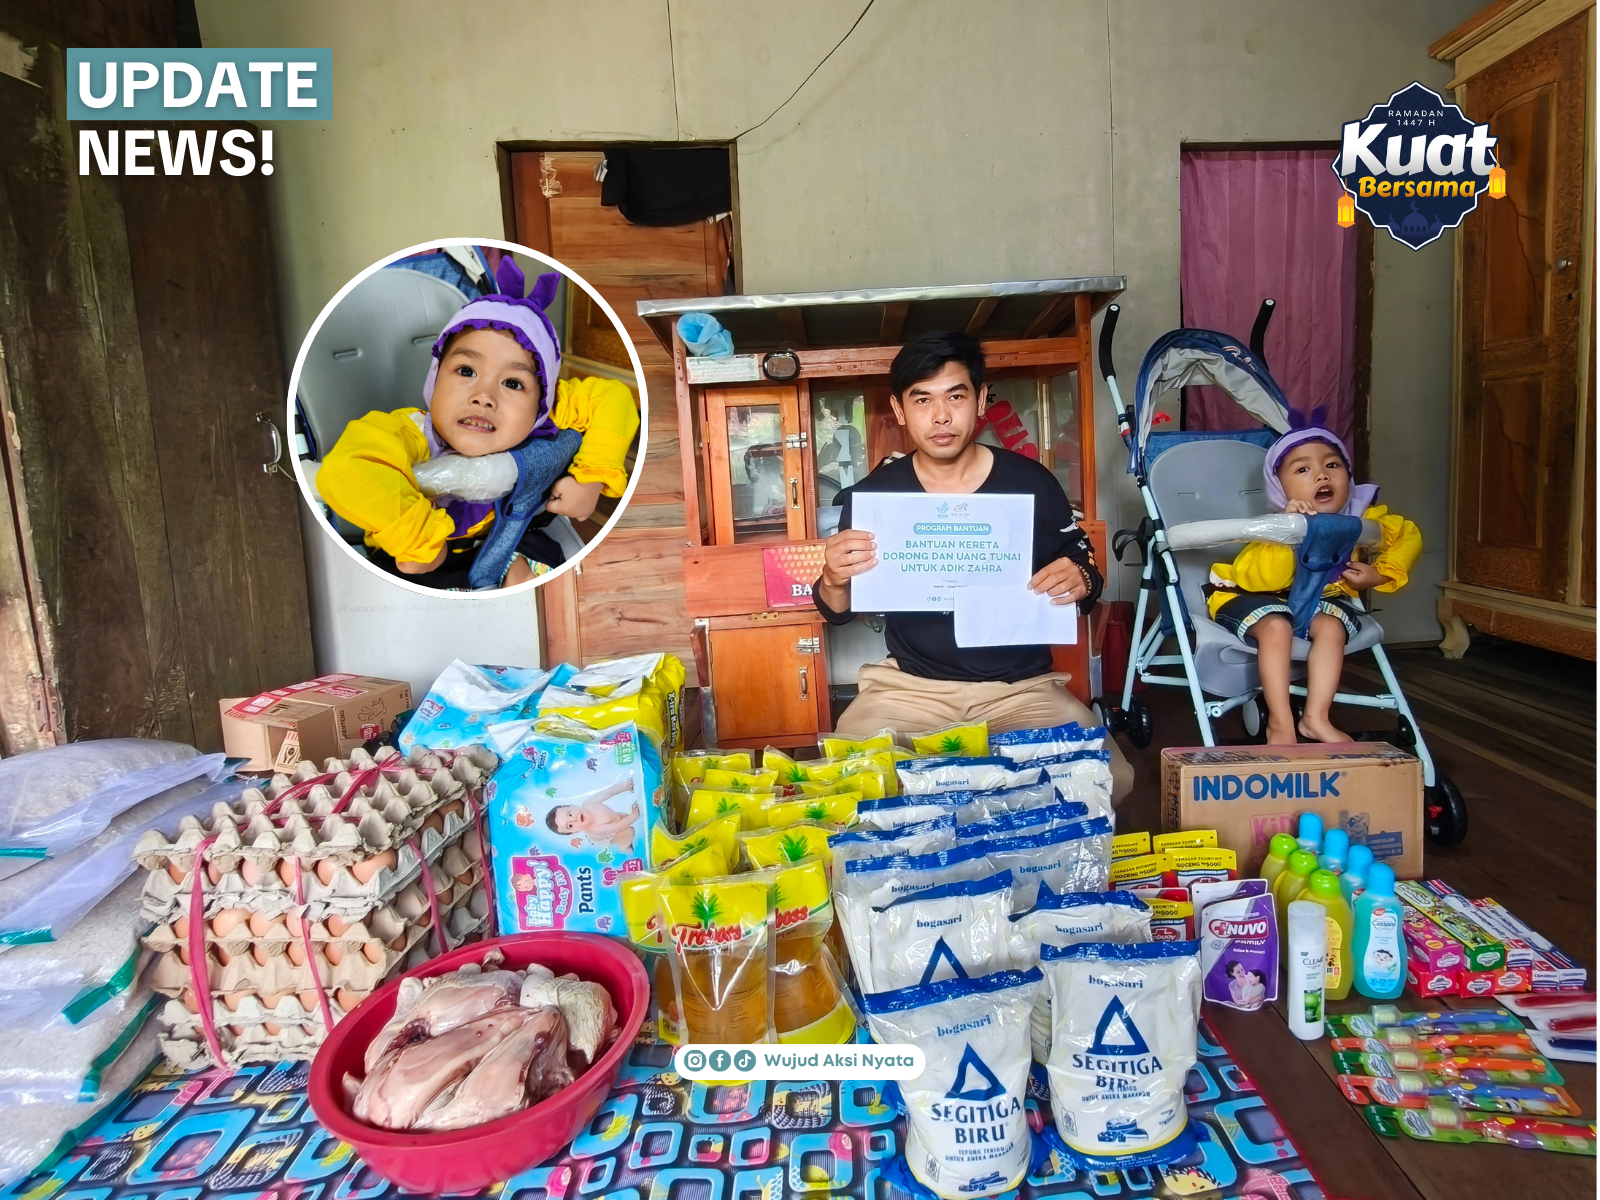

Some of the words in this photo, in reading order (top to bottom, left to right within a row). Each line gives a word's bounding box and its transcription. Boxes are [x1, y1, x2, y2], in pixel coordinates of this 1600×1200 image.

[916, 524, 952, 532] PROGRAM
[953, 524, 989, 532] BANTUAN
[905, 540, 956, 549] BANTUAN
[958, 540, 999, 549] KERETA
[883, 552, 929, 561] DORONG
[931, 552, 954, 561] DAN
[956, 552, 986, 561] UANG
[989, 552, 1021, 561] TUNAI
[901, 563, 938, 572] UNTUK
[940, 564, 965, 573] ADIK
[967, 564, 1002, 573] ZAHRA
[791, 583, 813, 597] BA
[622, 742, 632, 763] M32
[935, 778, 970, 788] bogasari
[1193, 771, 1340, 801] INDOMILK
[1019, 860, 1061, 874] bogasari
[554, 869, 567, 886] Fit
[526, 860, 555, 927] Happy!
[578, 867, 594, 914] Pants
[556, 886, 570, 915] Body
[526, 895, 539, 927] Baby
[916, 914, 962, 929] bogasari
[1055, 922, 1103, 935] bogasari
[1227, 921, 1267, 936] NUVO
[1302, 956, 1324, 966] CLEAR
[937, 1014, 991, 1037] bogasari
[1072, 1053, 1163, 1076] SEGITIGA
[1101, 1092, 1120, 1100] ANEKA
[931, 1096, 1021, 1124] SEGITIGA
[955, 1123, 1005, 1144] BIRU
[983, 1146, 1005, 1154] TERIGU
